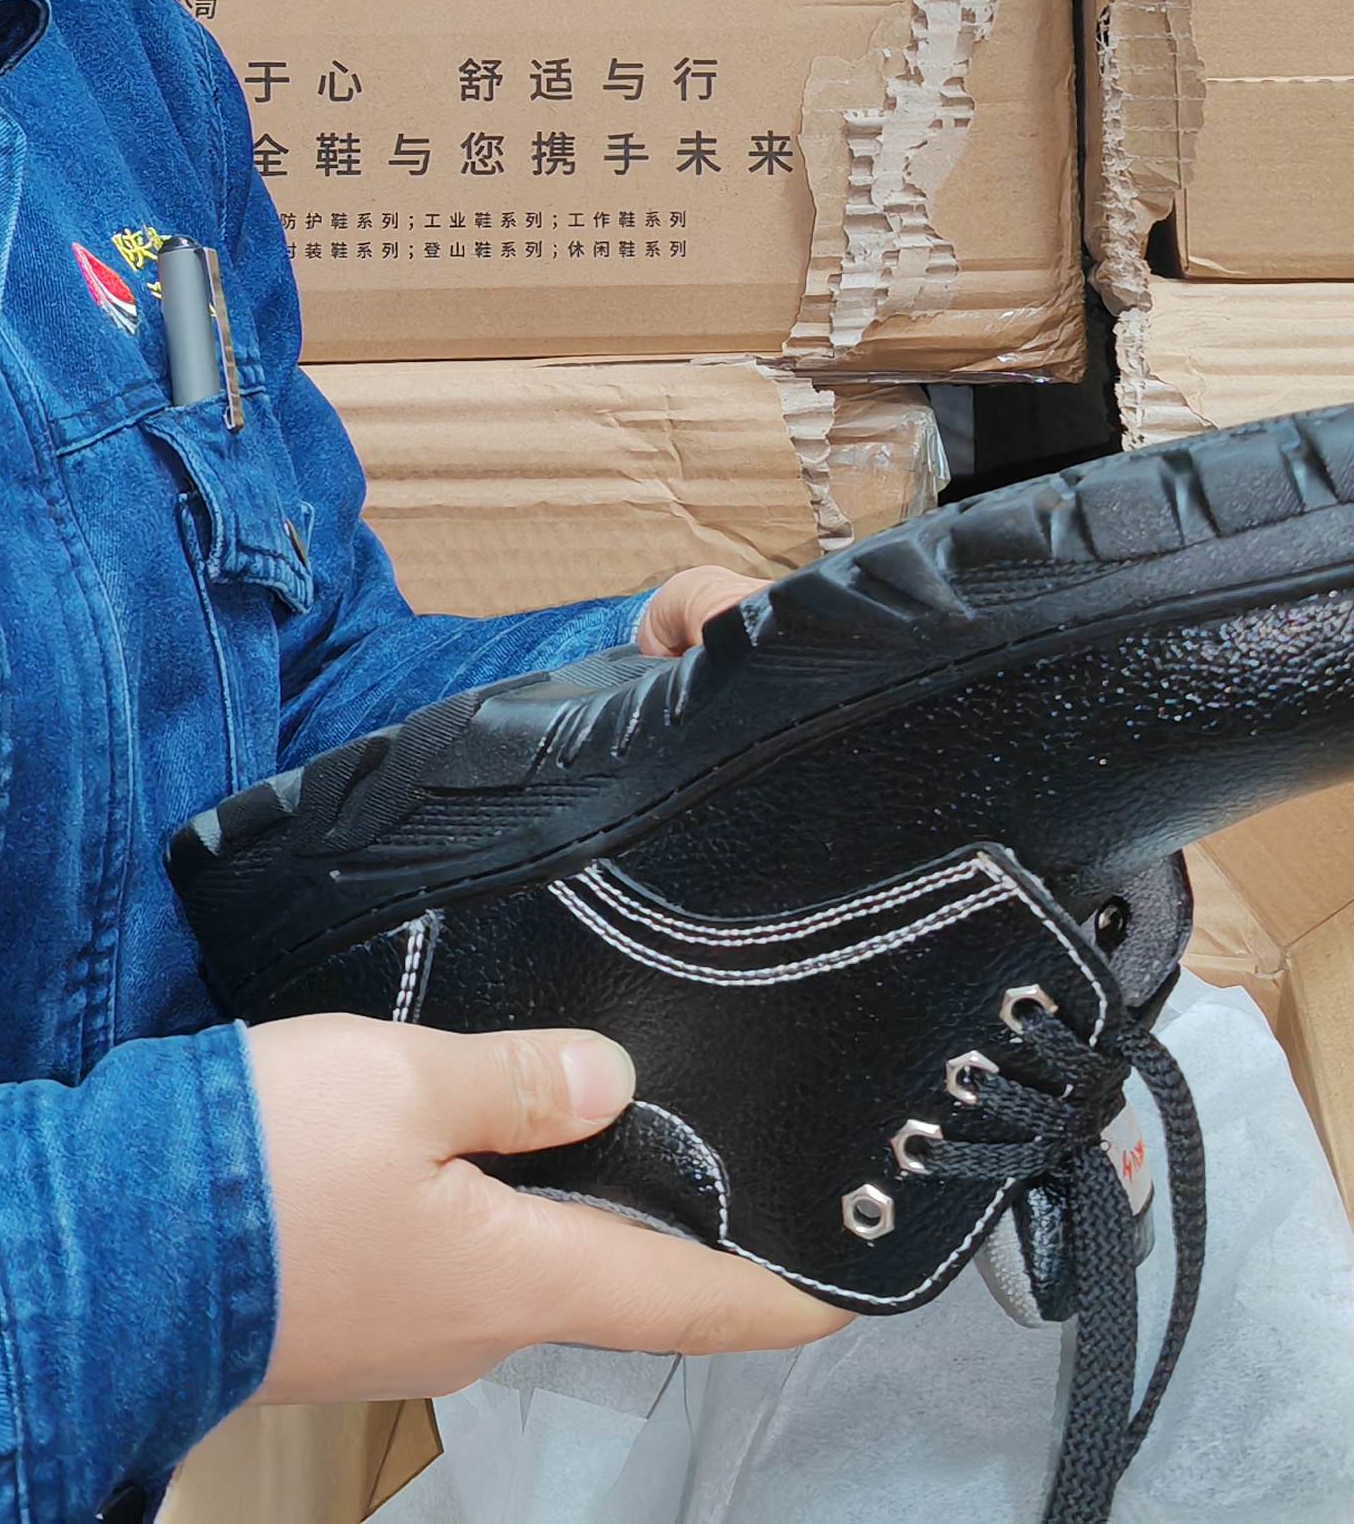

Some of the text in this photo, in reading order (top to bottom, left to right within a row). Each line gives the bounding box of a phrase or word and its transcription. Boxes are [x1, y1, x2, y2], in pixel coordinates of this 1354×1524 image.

[245, 56, 718, 104] 于心 舒适与行
[253, 129, 794, 178] 全鞋与您携手未来
